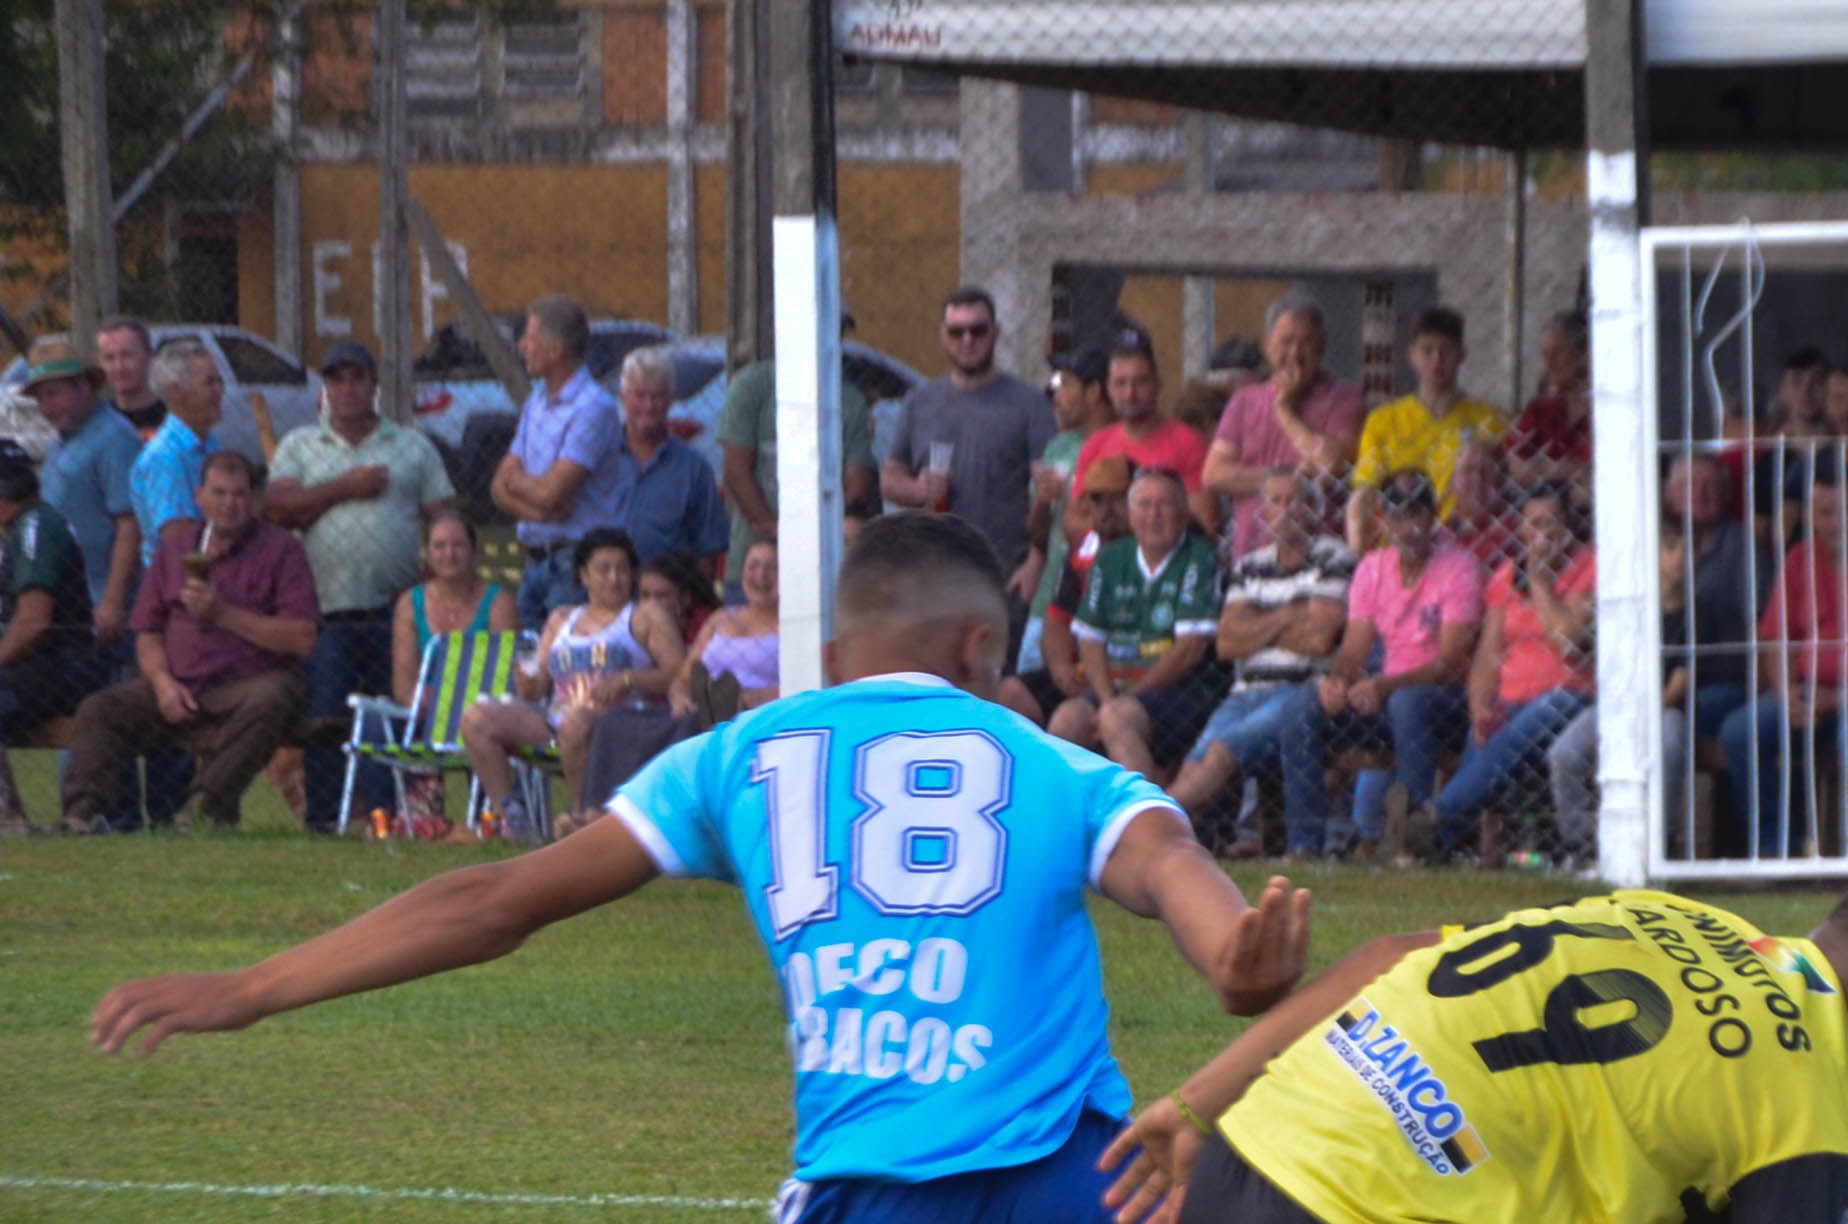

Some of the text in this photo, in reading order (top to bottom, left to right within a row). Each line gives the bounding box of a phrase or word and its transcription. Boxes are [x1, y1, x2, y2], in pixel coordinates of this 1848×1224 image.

[750, 727, 1013, 942] 18
[1428, 919, 1674, 1074] 69
[1609, 899, 1752, 1058] ARDOSO
[1348, 1010, 1463, 1139] D.ZANCO
[1371, 1078, 1450, 1175] CONSTRUÇÃO
